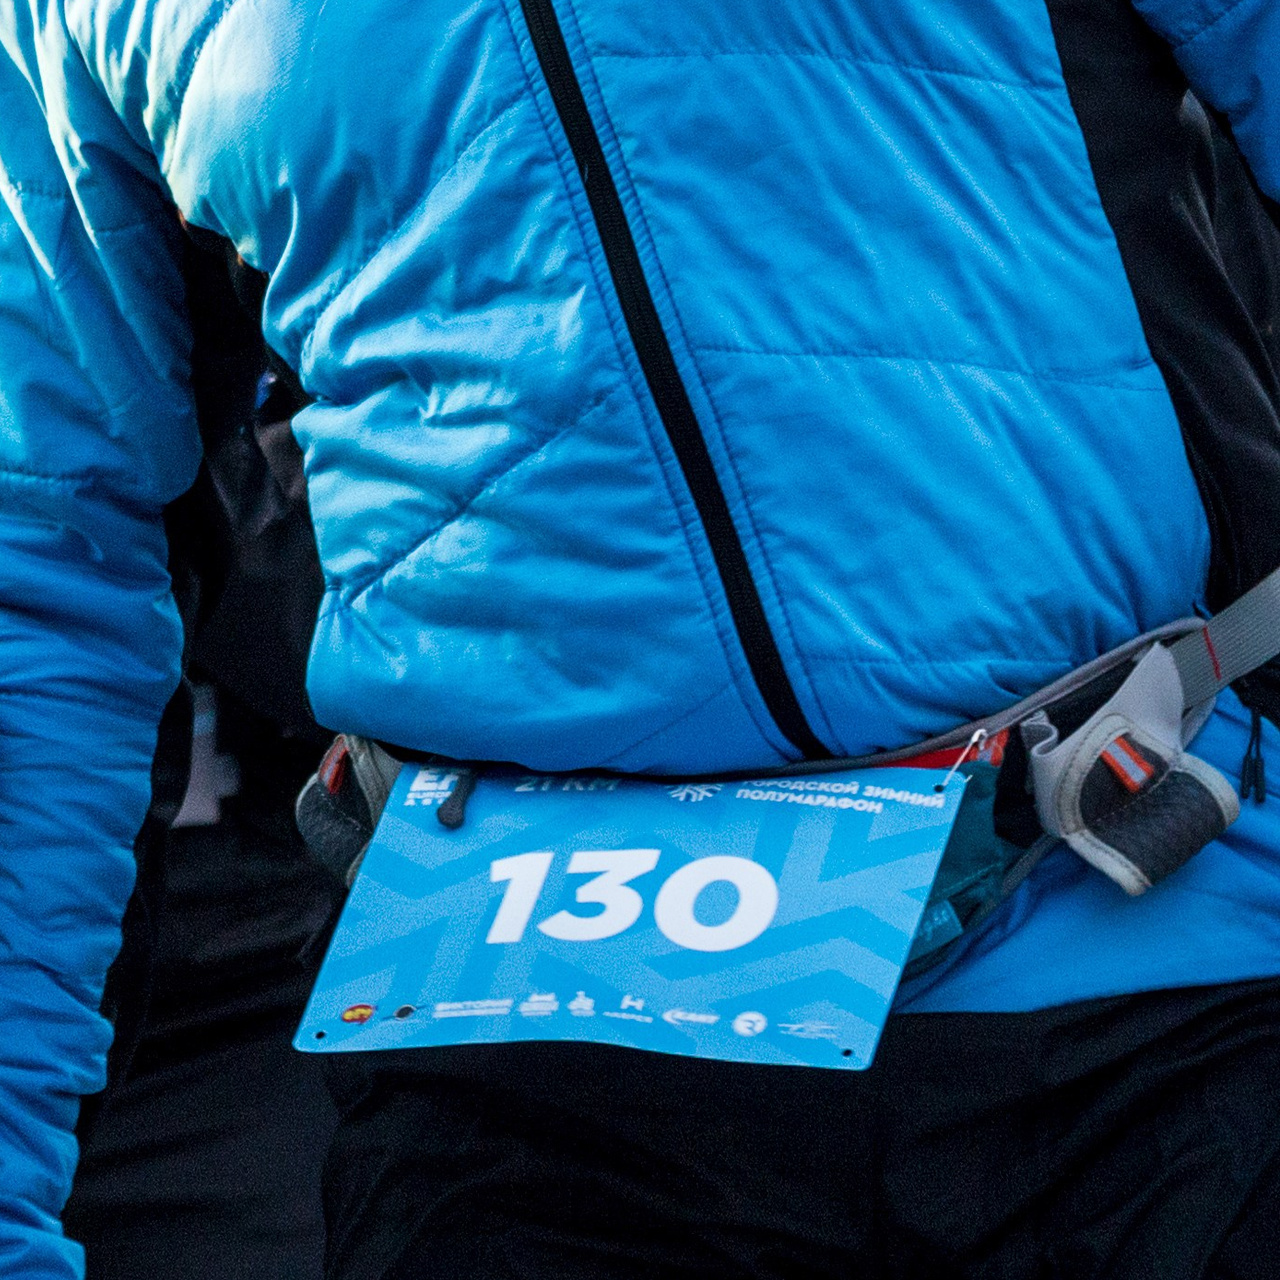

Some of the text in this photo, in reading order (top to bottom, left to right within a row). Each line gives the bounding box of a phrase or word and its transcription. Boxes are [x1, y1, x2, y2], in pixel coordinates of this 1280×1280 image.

[735, 788, 884, 814] ПОЛУМАРАФОН
[862, 784, 946, 809] ЗИМНИЙ
[486, 848, 779, 952] 130
